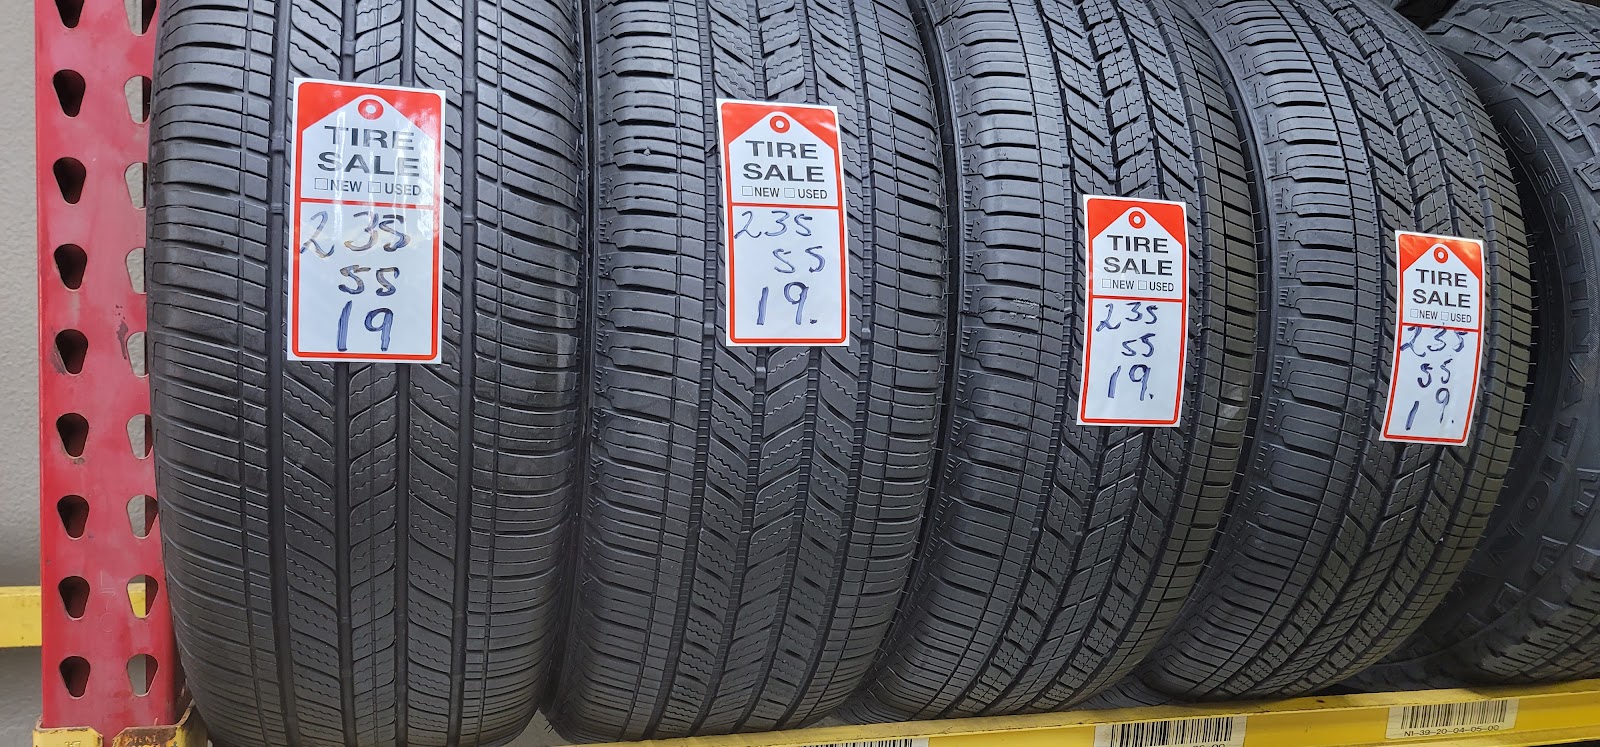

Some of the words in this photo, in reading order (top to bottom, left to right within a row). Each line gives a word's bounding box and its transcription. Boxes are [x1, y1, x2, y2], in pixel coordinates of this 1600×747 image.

[324, 125, 414, 151] TIRE
[745, 140, 818, 160] TIRE
[317, 151, 420, 177] SALE
[743, 162, 825, 183] SALE
[330, 180, 362, 193] NEW
[384, 183, 422, 197] USED
[754, 186, 780, 198] NEW
[798, 188, 828, 200] USED
[300, 210, 411, 258] 235
[733, 210, 813, 239] 235
[1106, 234, 1169, 254] TIRE
[772, 245, 826, 273] 55
[1103, 256, 1173, 276] SALE
[338, 264, 400, 297] 55
[1112, 279, 1135, 290] NEW
[1149, 281, 1174, 292] USED
[1415, 268, 1468, 288] TIRE
[1412, 288, 1471, 309] SALE
[337, 300, 394, 351] 19
[1095, 301, 1159, 332] 235
[1419, 309, 1439, 320] NEW
[1450, 312, 1472, 323] USED
[1121, 332, 1156, 357] 55
[1400, 326, 1468, 357] 235
[1417, 358, 1453, 388] 55
